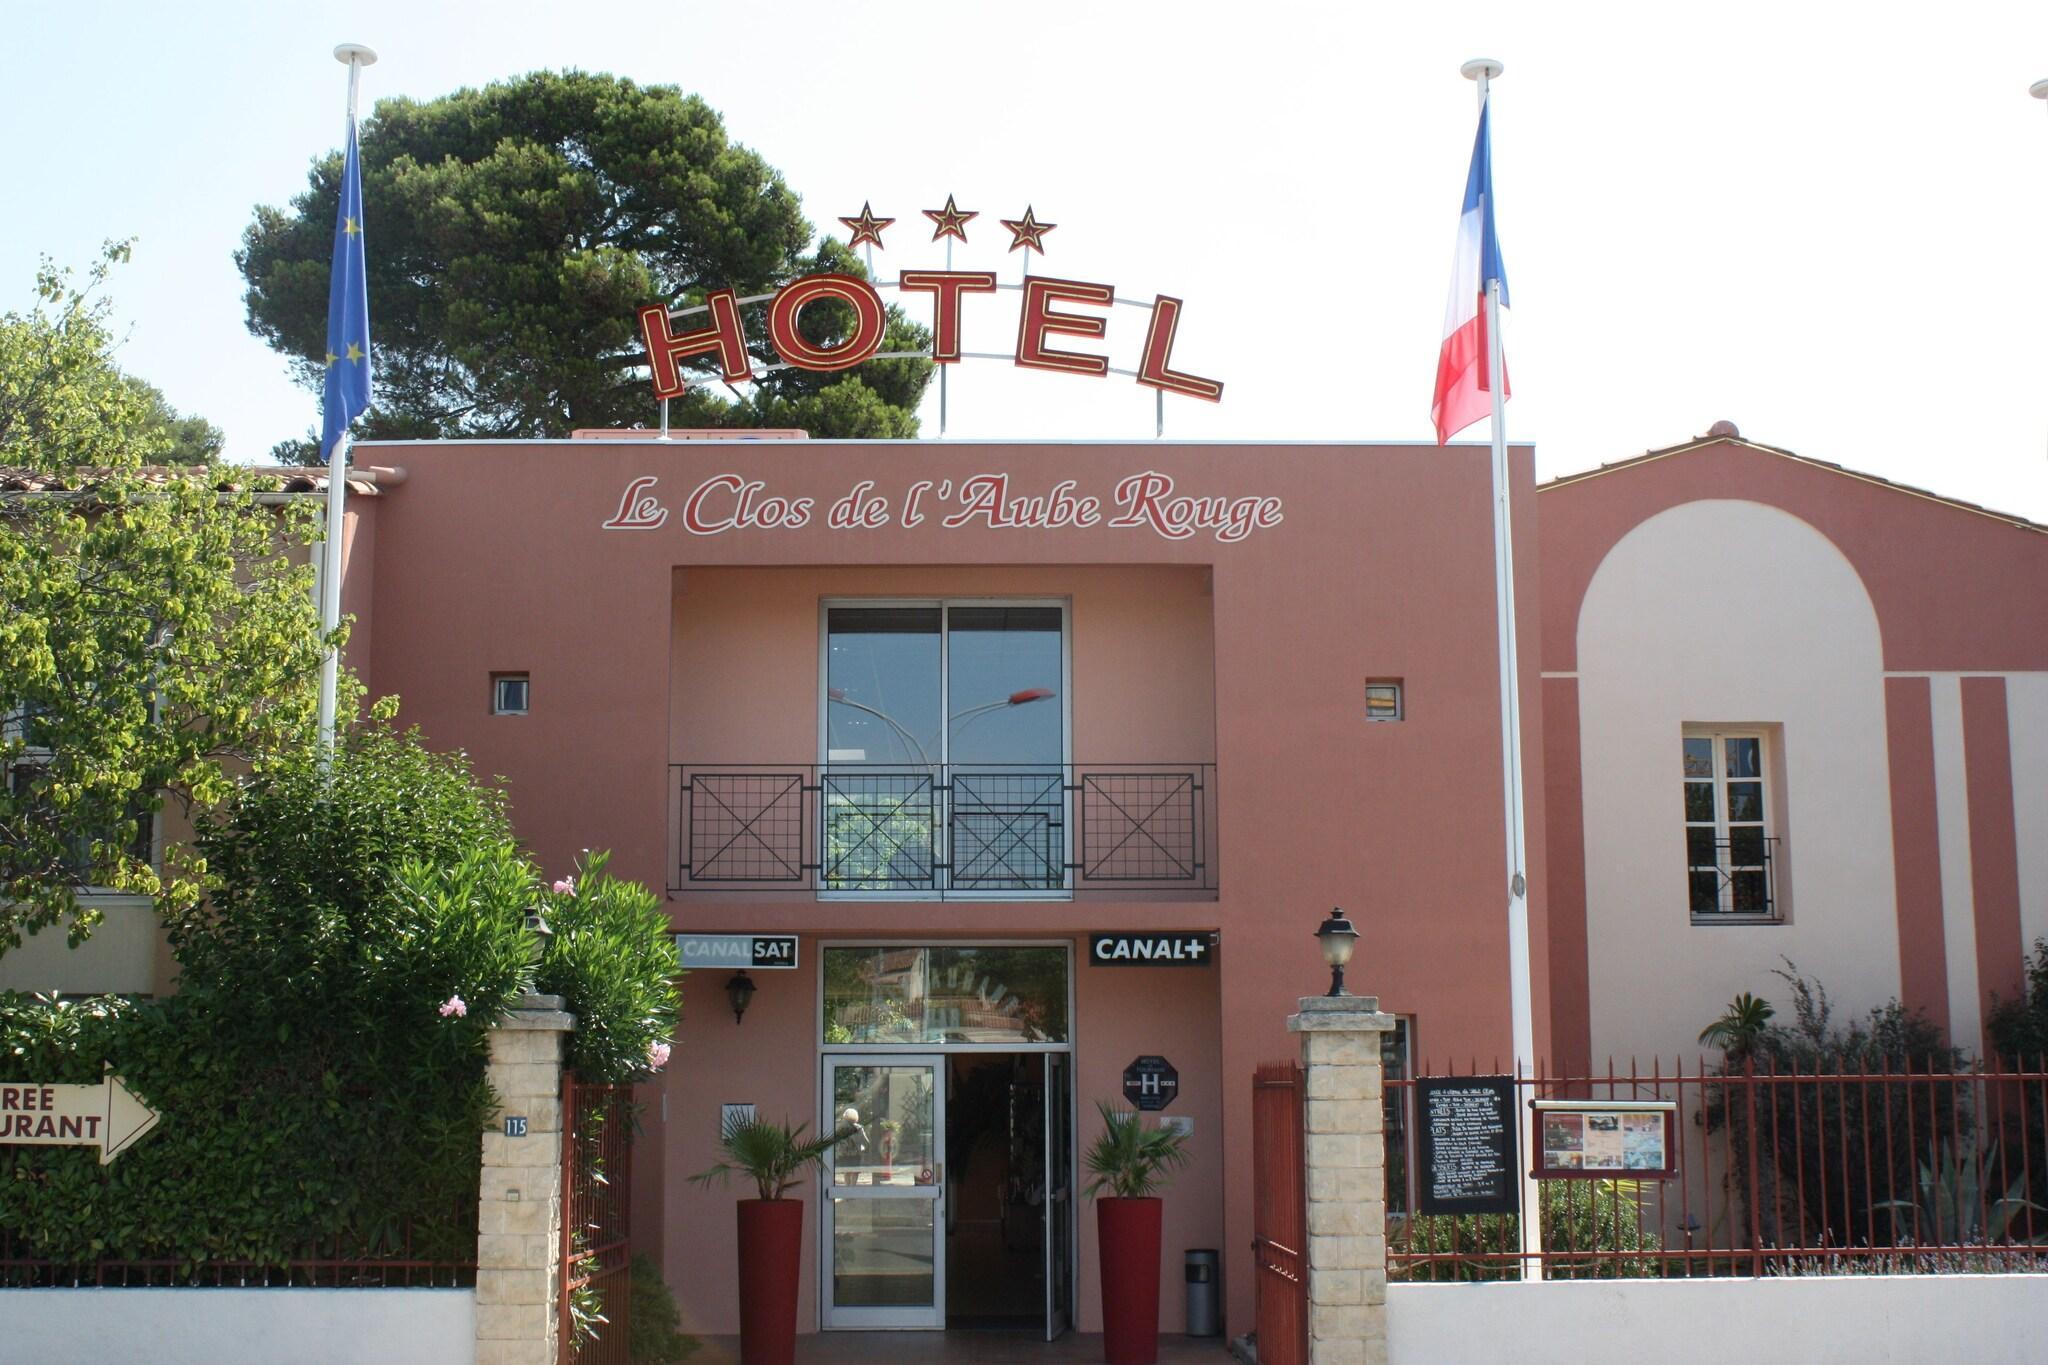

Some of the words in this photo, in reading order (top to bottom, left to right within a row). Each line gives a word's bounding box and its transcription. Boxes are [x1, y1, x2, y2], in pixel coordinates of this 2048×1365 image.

[638, 269, 1225, 403] HOTEL
[602, 476, 668, 531] Le
[683, 474, 815, 536] Clos
[828, 480, 889, 530] de
[901, 473, 1101, 531] l'Aube
[1110, 471, 1285, 543] Rouge
[1096, 939, 1205, 959] CANAL+
[1141, 1073, 1160, 1095] H
[1, 1088, 55, 1111] REE
[506, 1119, 527, 1135] 115
